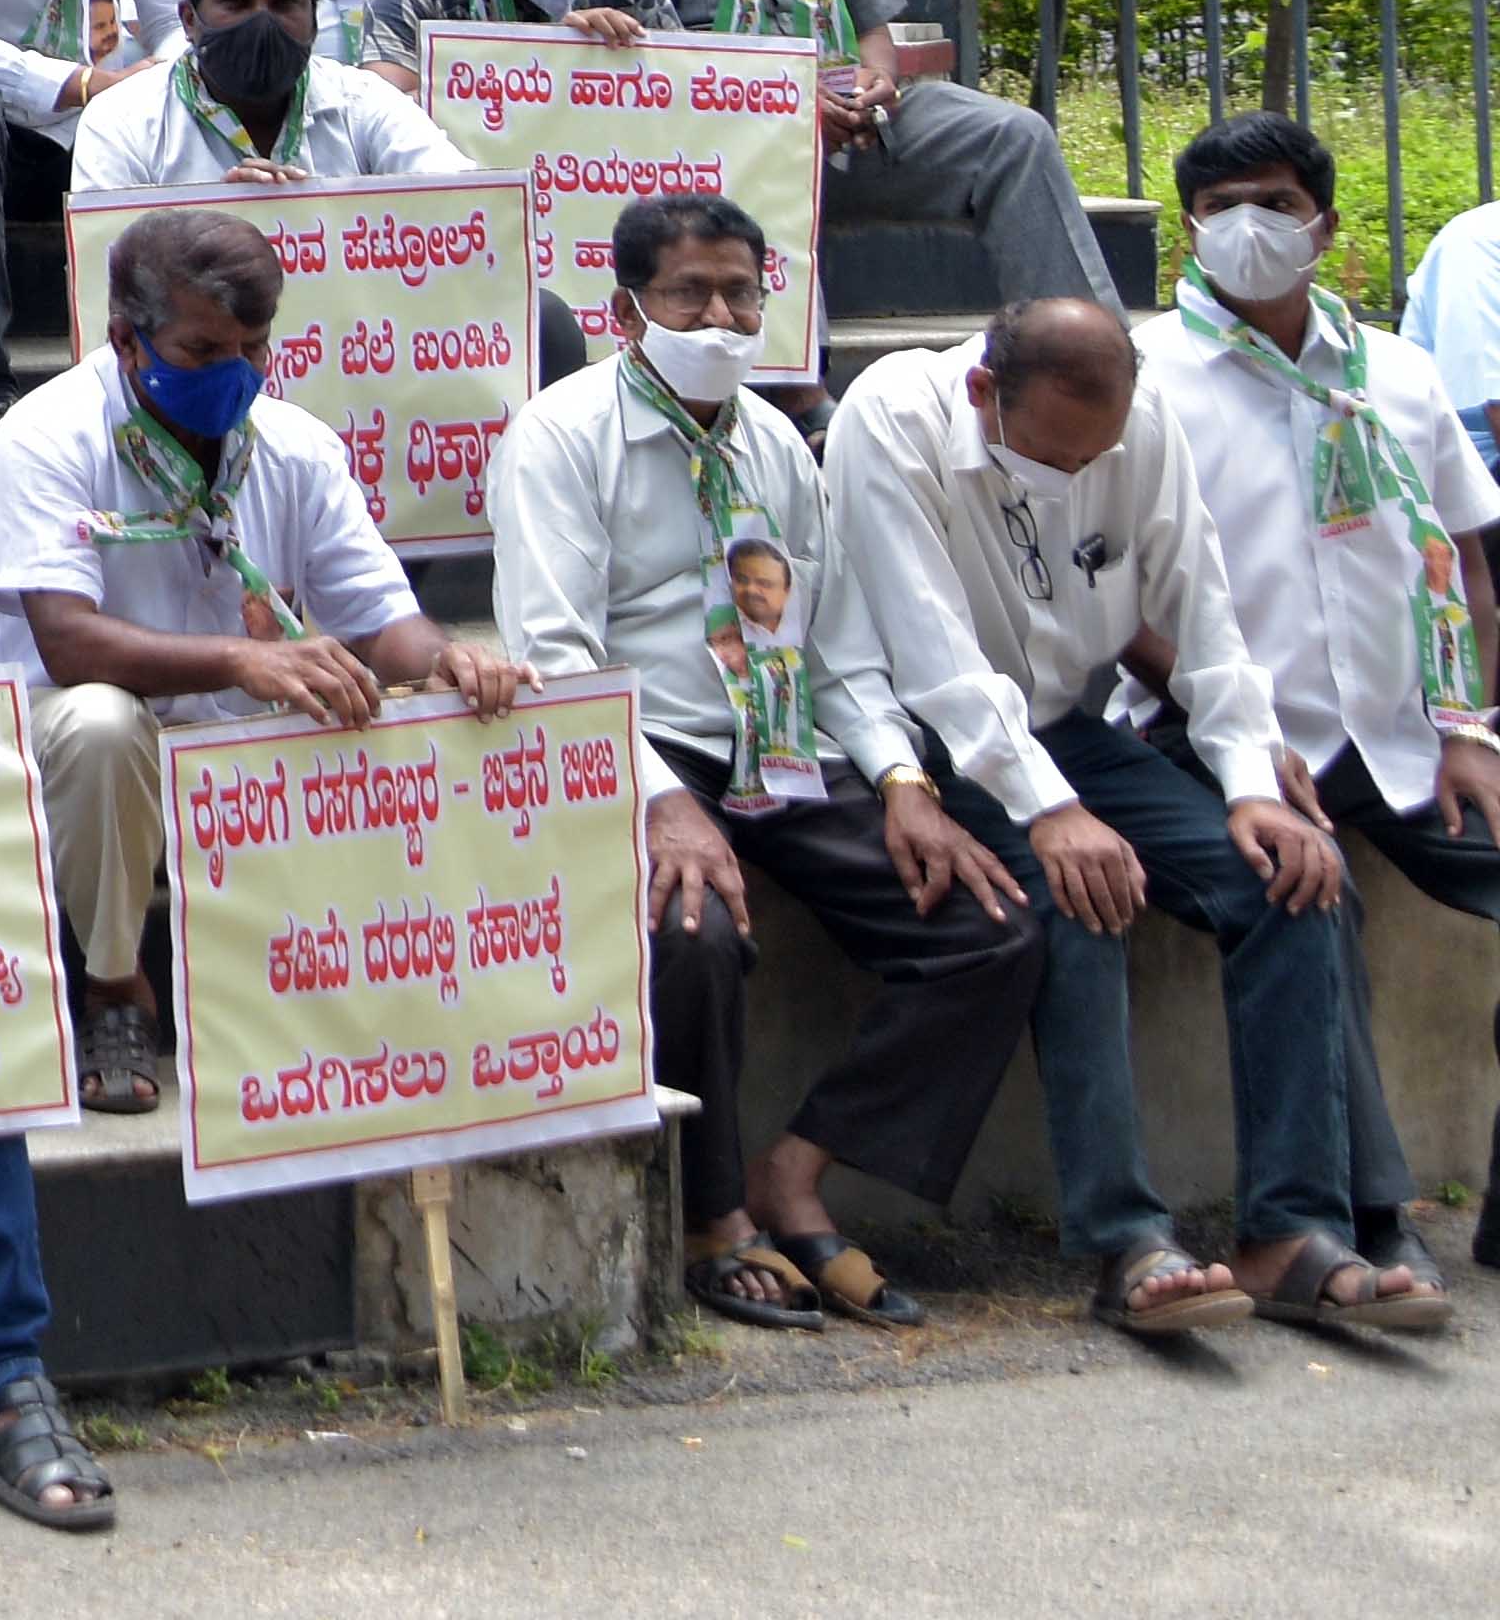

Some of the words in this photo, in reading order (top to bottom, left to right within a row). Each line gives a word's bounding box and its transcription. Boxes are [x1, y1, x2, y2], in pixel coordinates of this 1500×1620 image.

[571, 61, 673, 109] ಹಾಗೂ
[691, 67, 799, 115] ಕೋಮ
[342, 320, 396, 376] ಬೆಲೆ
[413, 324, 512, 372] ಖಂಡಿಸಿ
[190, 760, 291, 889] ರೈತರಿಗೆ
[301, 751, 441, 867] ರಸಗೊಬ್ಬರ
[481, 727, 550, 840] ಬಿತ್ತನೆ
[560, 740, 619, 802] ಬೀಜ
[268, 910, 352, 995] ಕಡಿಮೆ
[363, 897, 460, 1001] ದರದಲ್ಲಿ
[241, 1047, 448, 1124] ಒದಗಿಸಲು
[472, 1014, 620, 1102] ಒತ್ತಾಯ
